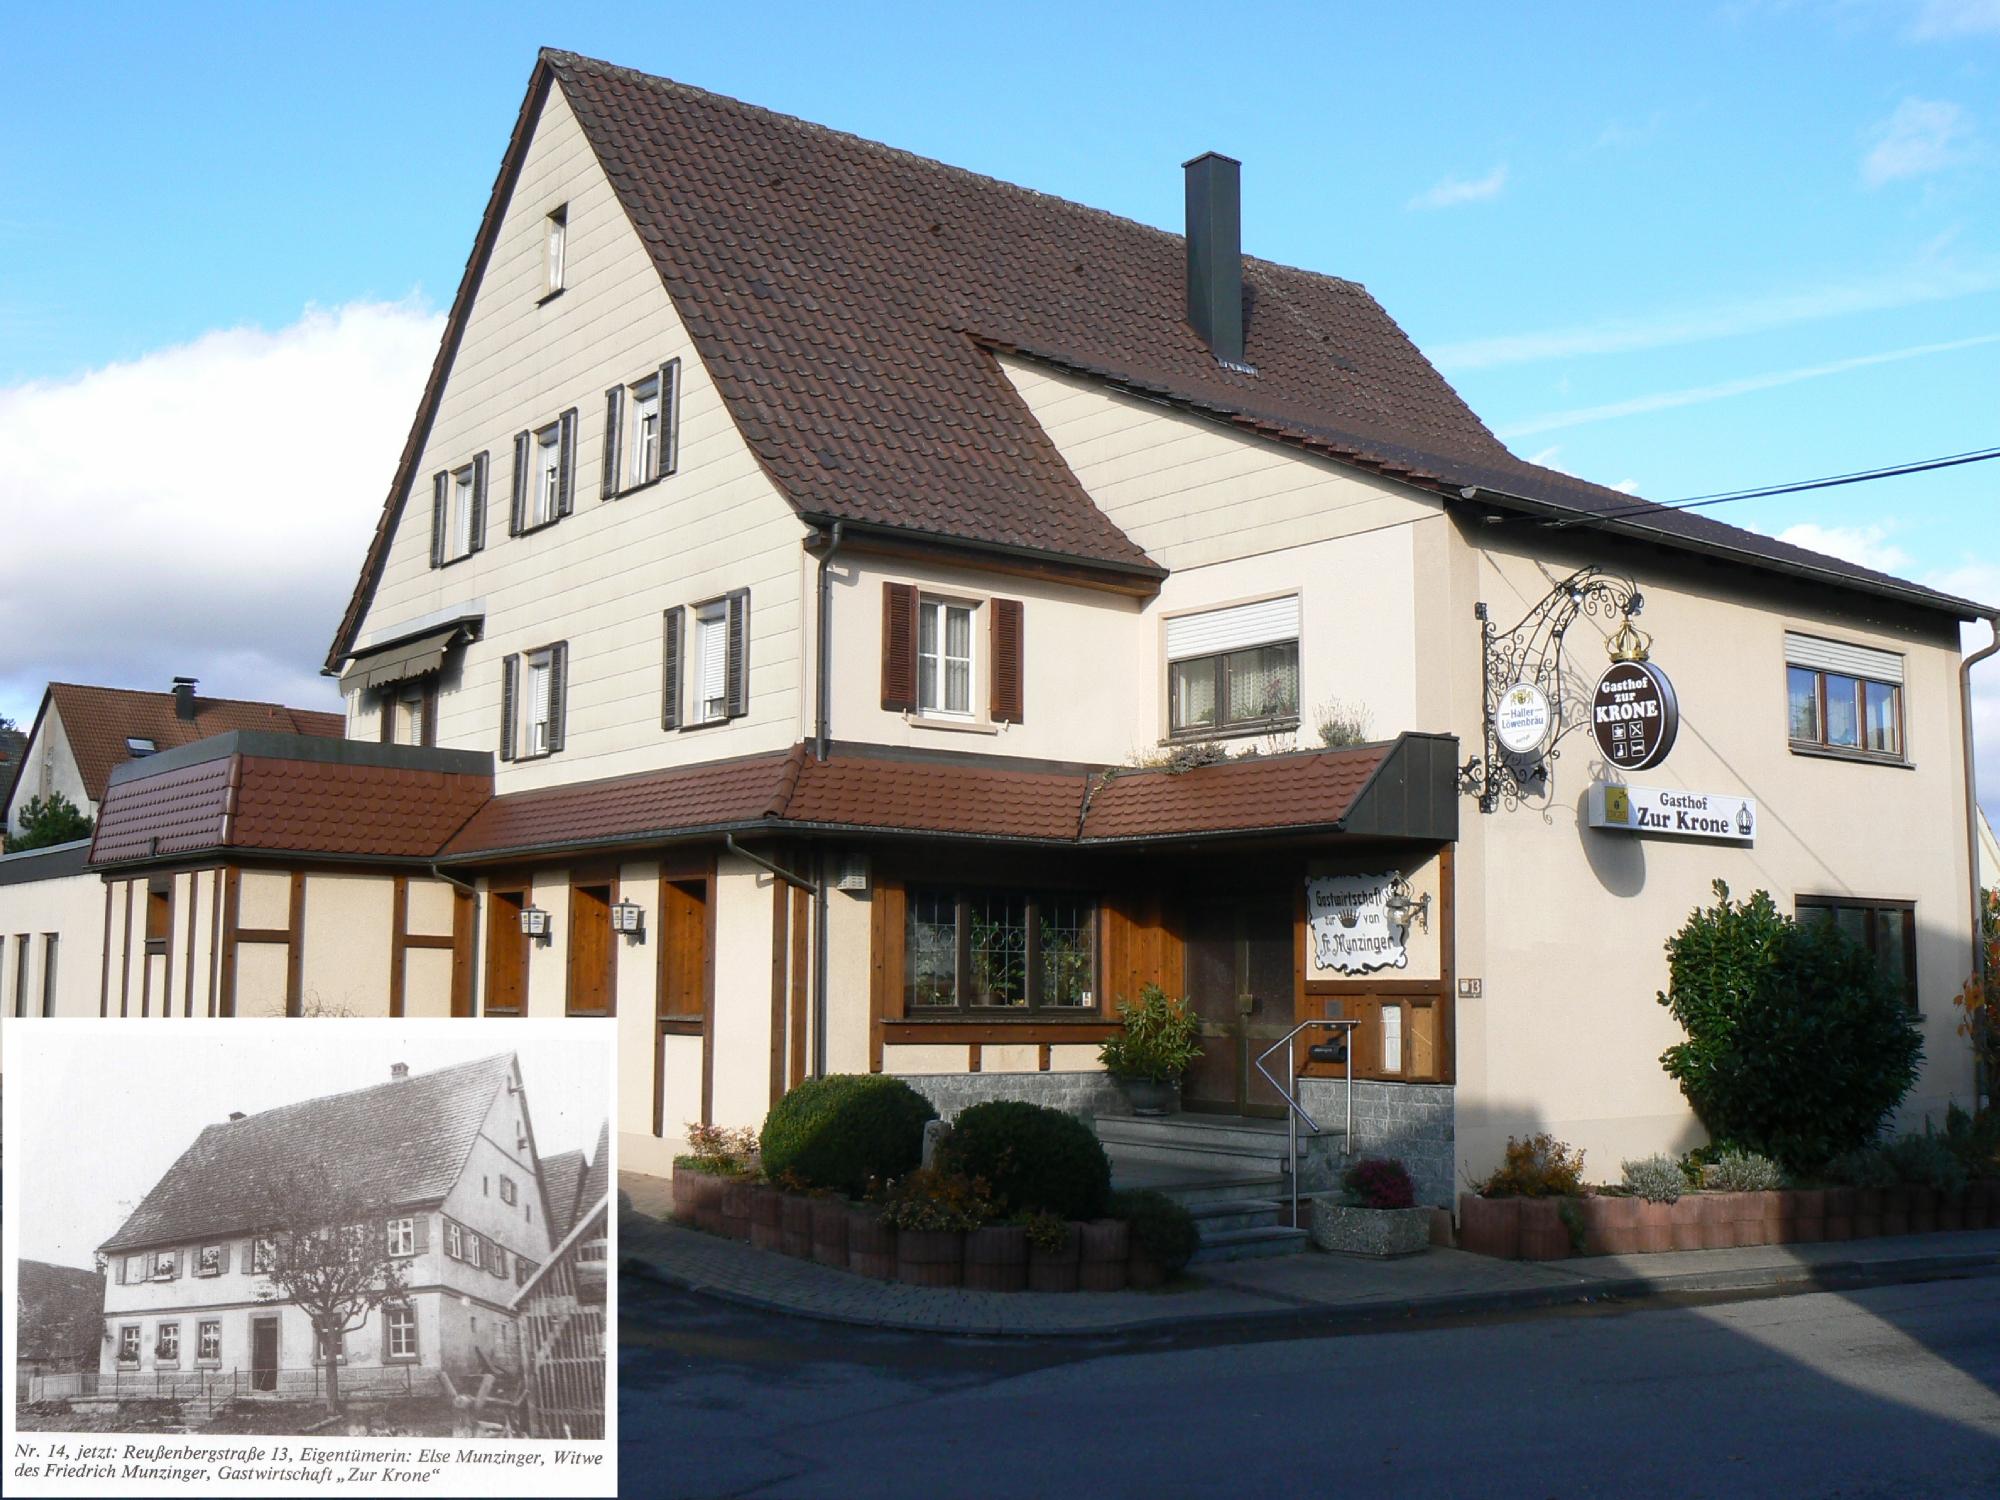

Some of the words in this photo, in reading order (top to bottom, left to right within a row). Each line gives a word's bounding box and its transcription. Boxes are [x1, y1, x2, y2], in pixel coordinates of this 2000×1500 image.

[1601, 676, 1649, 694] Gasthof
[1614, 692, 1636, 703] zur
[1510, 708, 1534, 719] Haller
[1596, 700, 1658, 723] KRONE
[1502, 715, 1544, 729] Löwenbräu
[1659, 792, 1708, 810] Gasthof
[1637, 807, 1671, 829] Zur
[1676, 810, 1729, 834] Krone
[1315, 886, 1383, 907] Gastwirtschaft
[1363, 914, 1380, 924] von
[1332, 933, 1394, 956] Munzinger
[1469, 979, 1481, 993] 13
